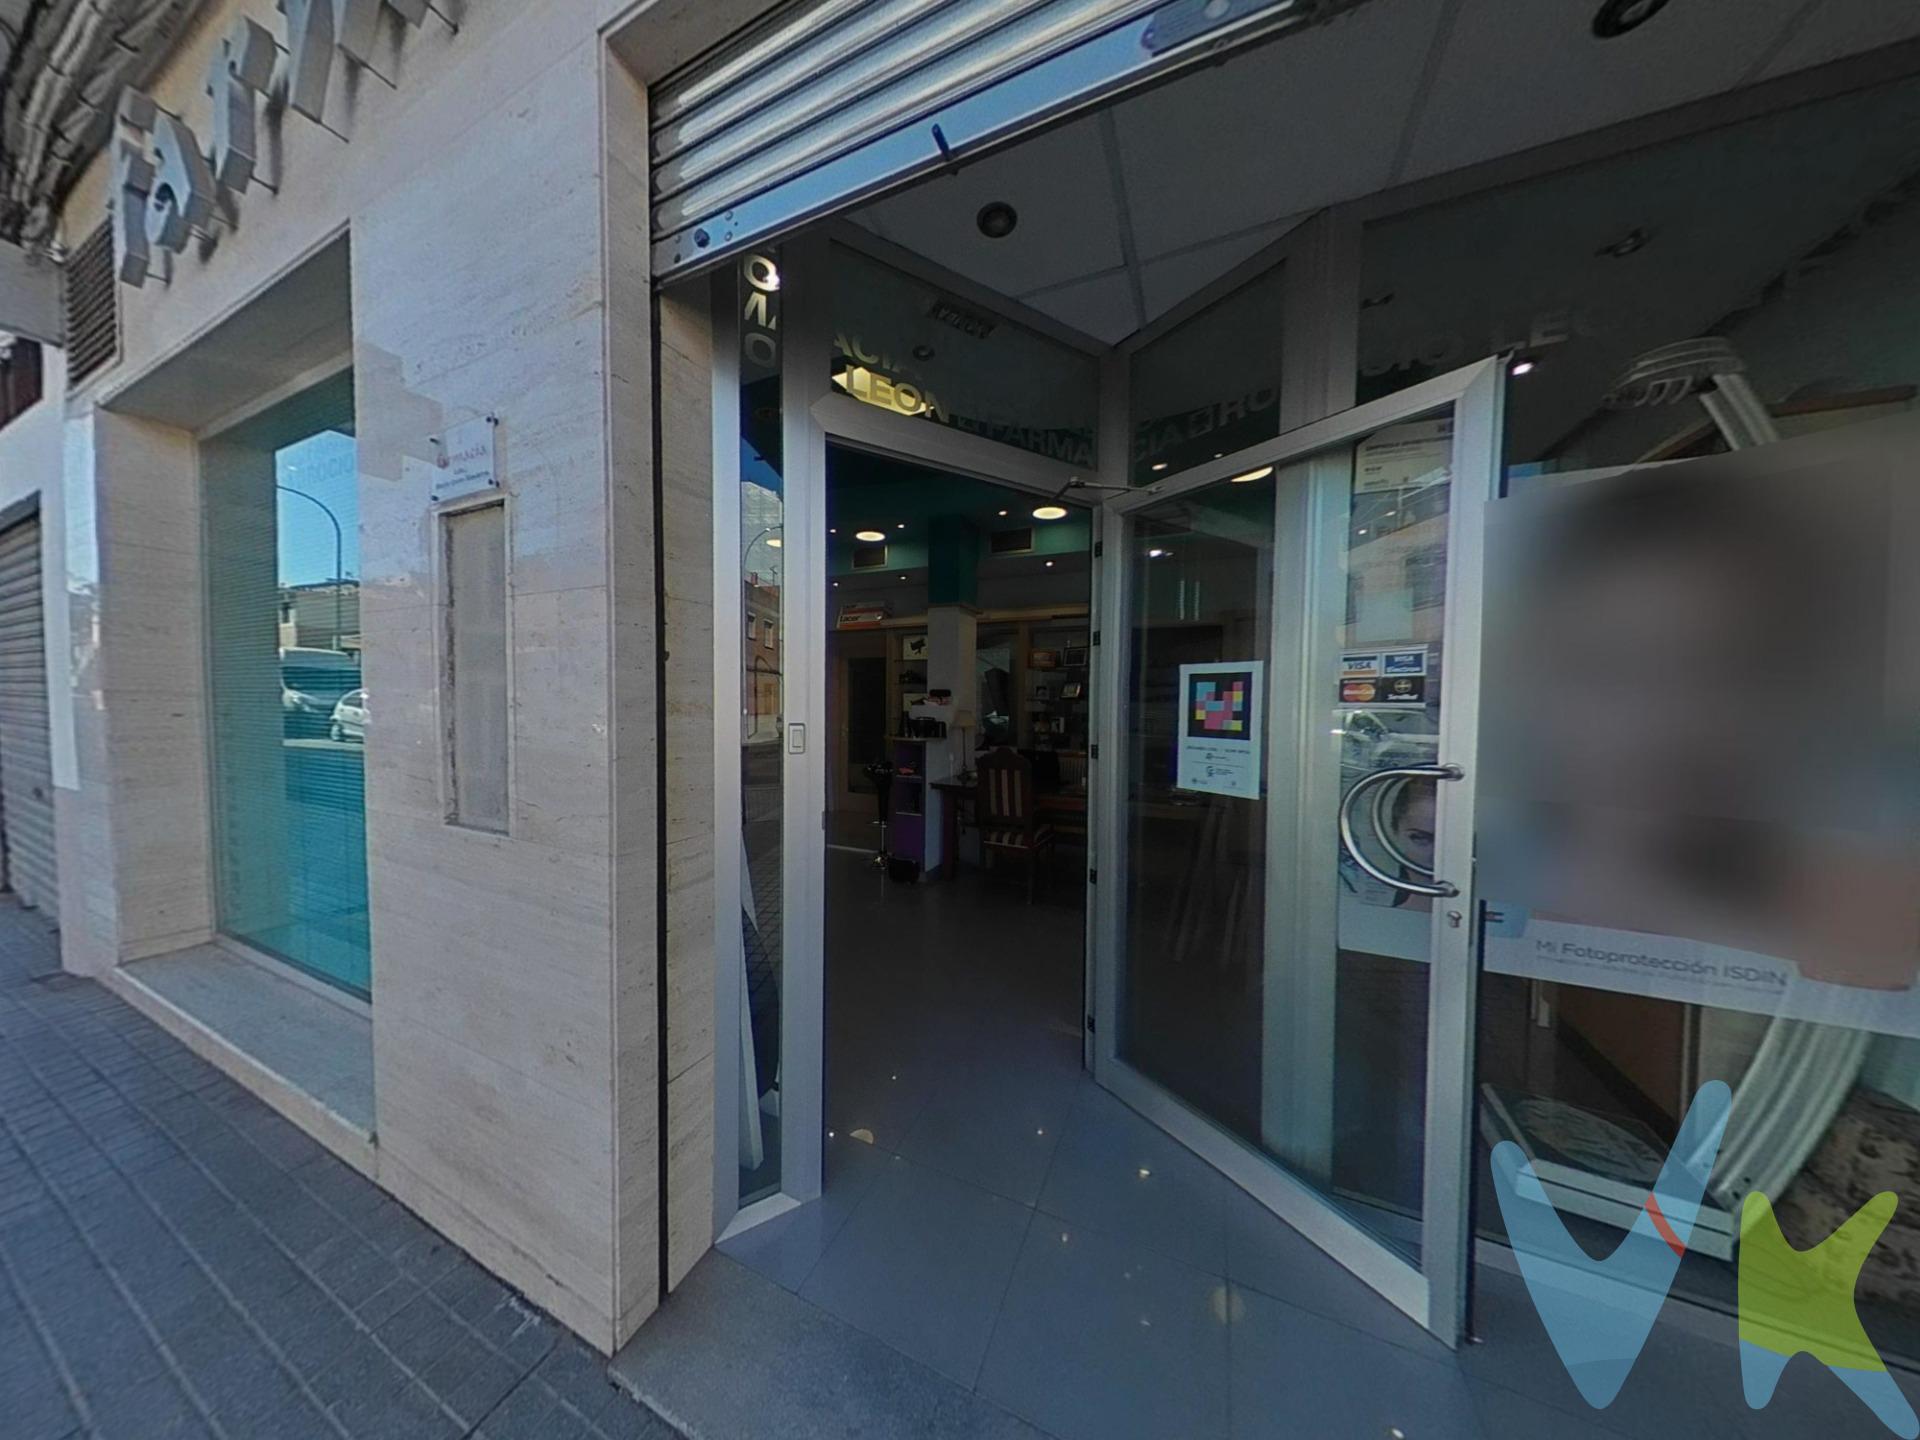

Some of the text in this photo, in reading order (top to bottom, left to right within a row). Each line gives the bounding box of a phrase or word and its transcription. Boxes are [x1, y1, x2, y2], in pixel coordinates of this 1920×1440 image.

[845, 364, 951, 424] LEON
[1348, 661, 1371, 670] VISA
[1561, 942, 1718, 977] Fotoprotección
